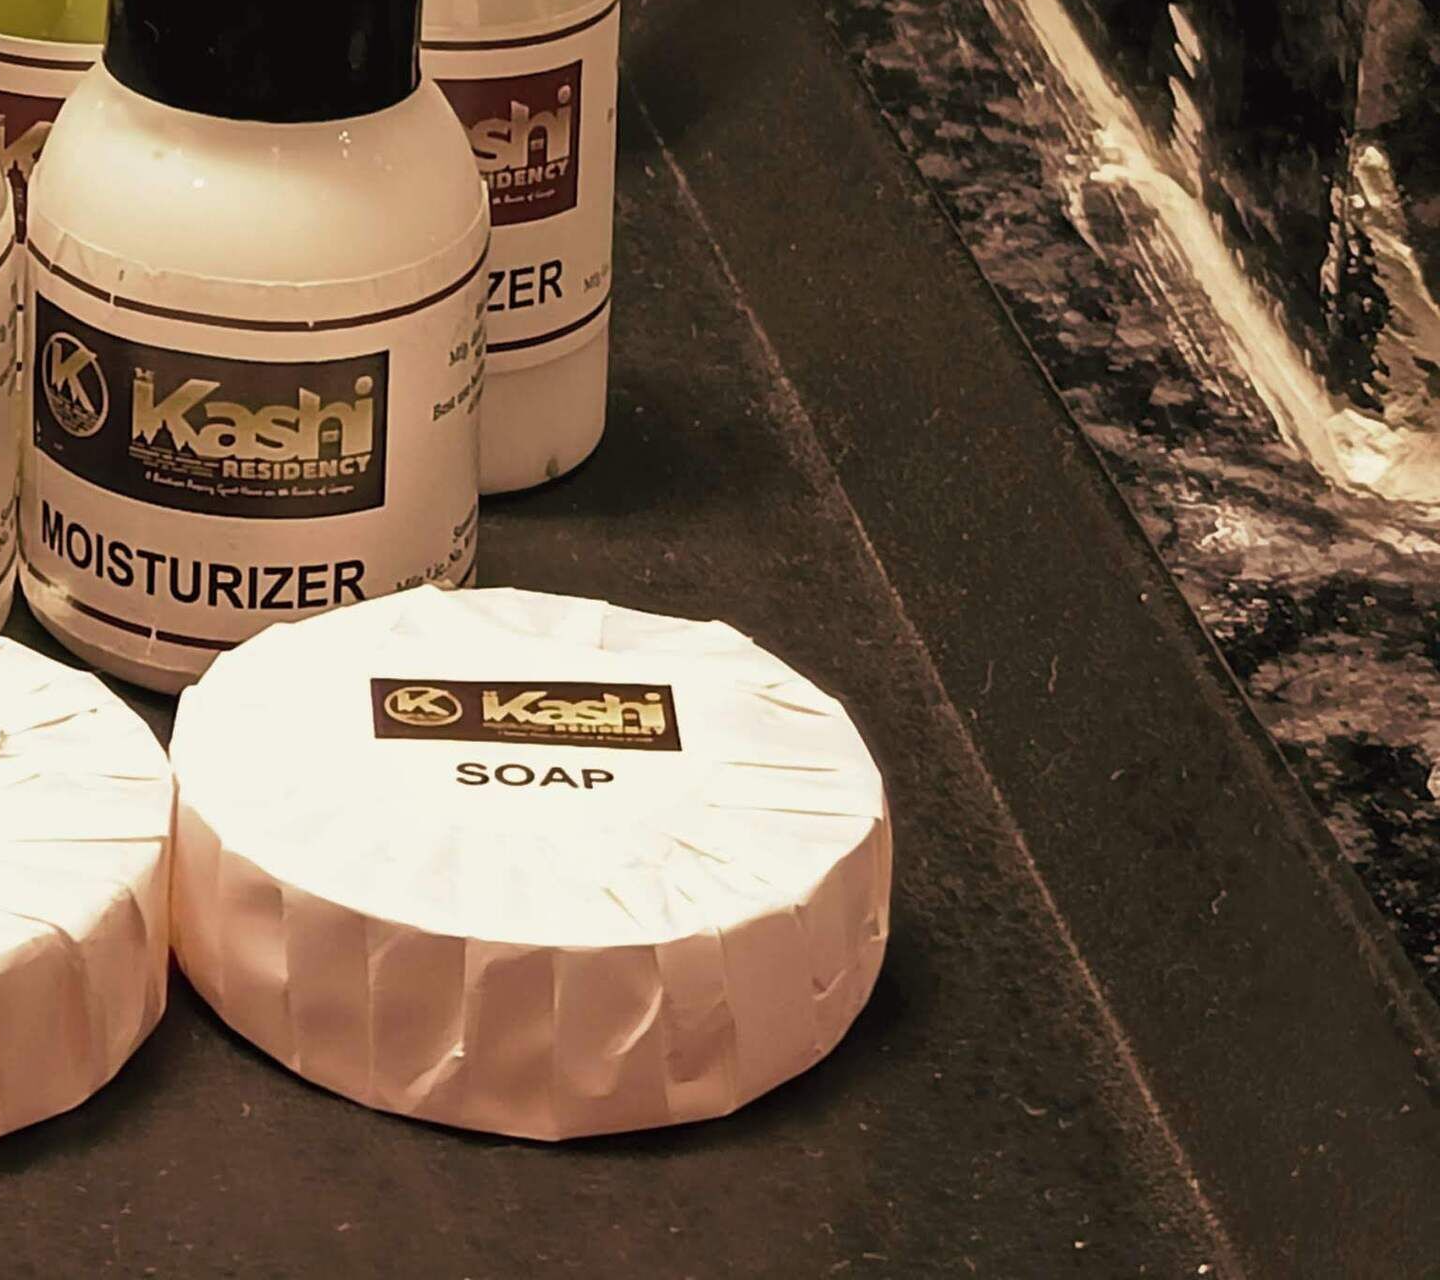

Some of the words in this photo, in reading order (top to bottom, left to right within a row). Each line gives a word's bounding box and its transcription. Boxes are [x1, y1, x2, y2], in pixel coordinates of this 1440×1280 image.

[487, 259, 563, 312] ZER
[132, 375, 374, 462] Kashi
[222, 454, 372, 482] RESIDENCY
[42, 500, 366, 610] MOISTURIZER
[482, 691, 666, 731] Kashi
[456, 762, 614, 790] SOAP
